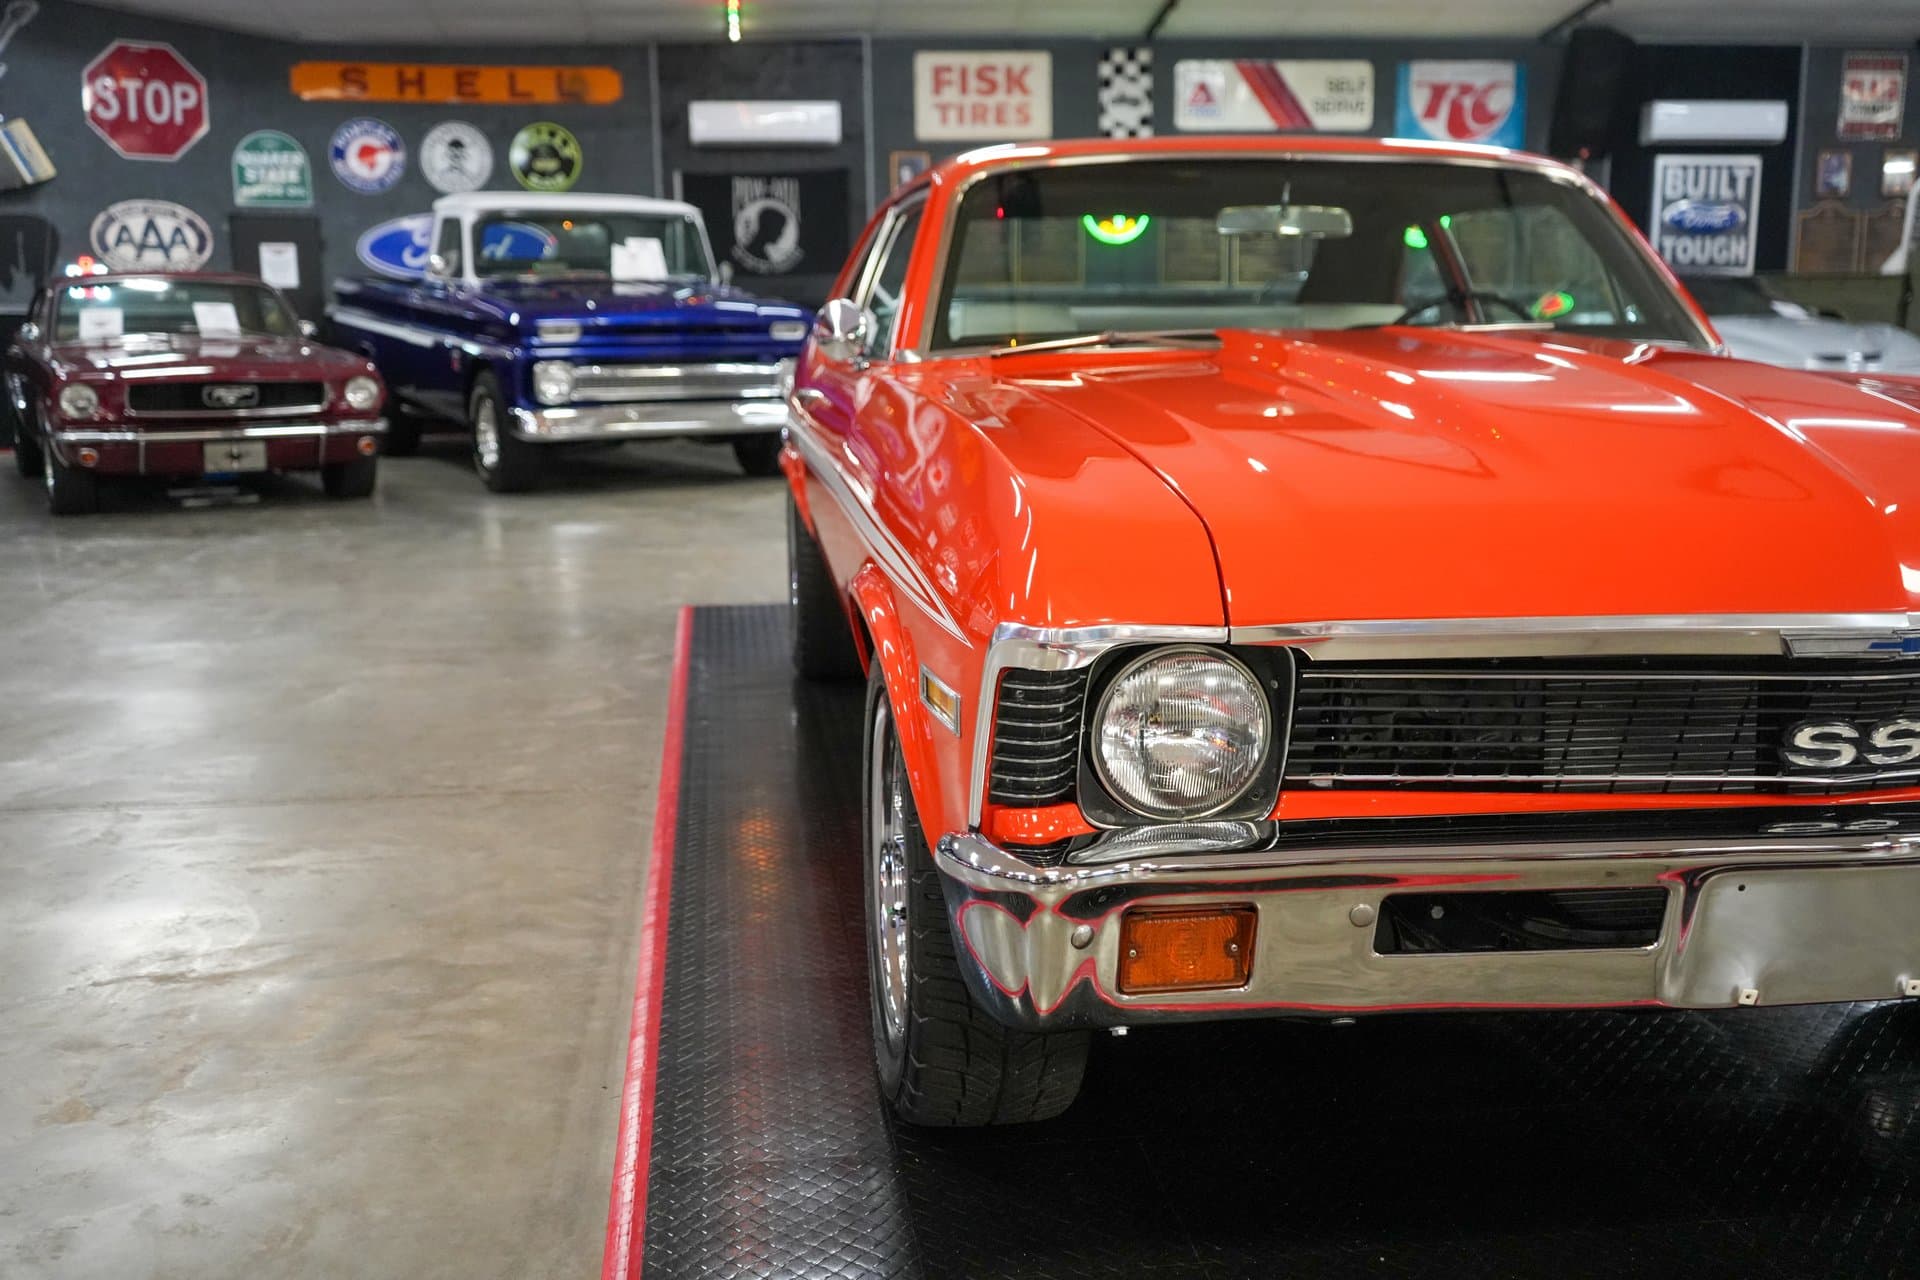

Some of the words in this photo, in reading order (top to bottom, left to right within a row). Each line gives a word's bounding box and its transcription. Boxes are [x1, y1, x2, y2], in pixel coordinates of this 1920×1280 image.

[339, 66, 592, 99] SHELL
[932, 64, 1033, 96] FISK
[94, 76, 198, 126] STOP
[933, 102, 1032, 126] TIRES
[1415, 81, 1514, 139] RC
[1663, 166, 1754, 200] BUILT
[115, 217, 192, 260] AAA
[1662, 234, 1748, 265] TOUGH
[1785, 717, 1920, 768] SS
